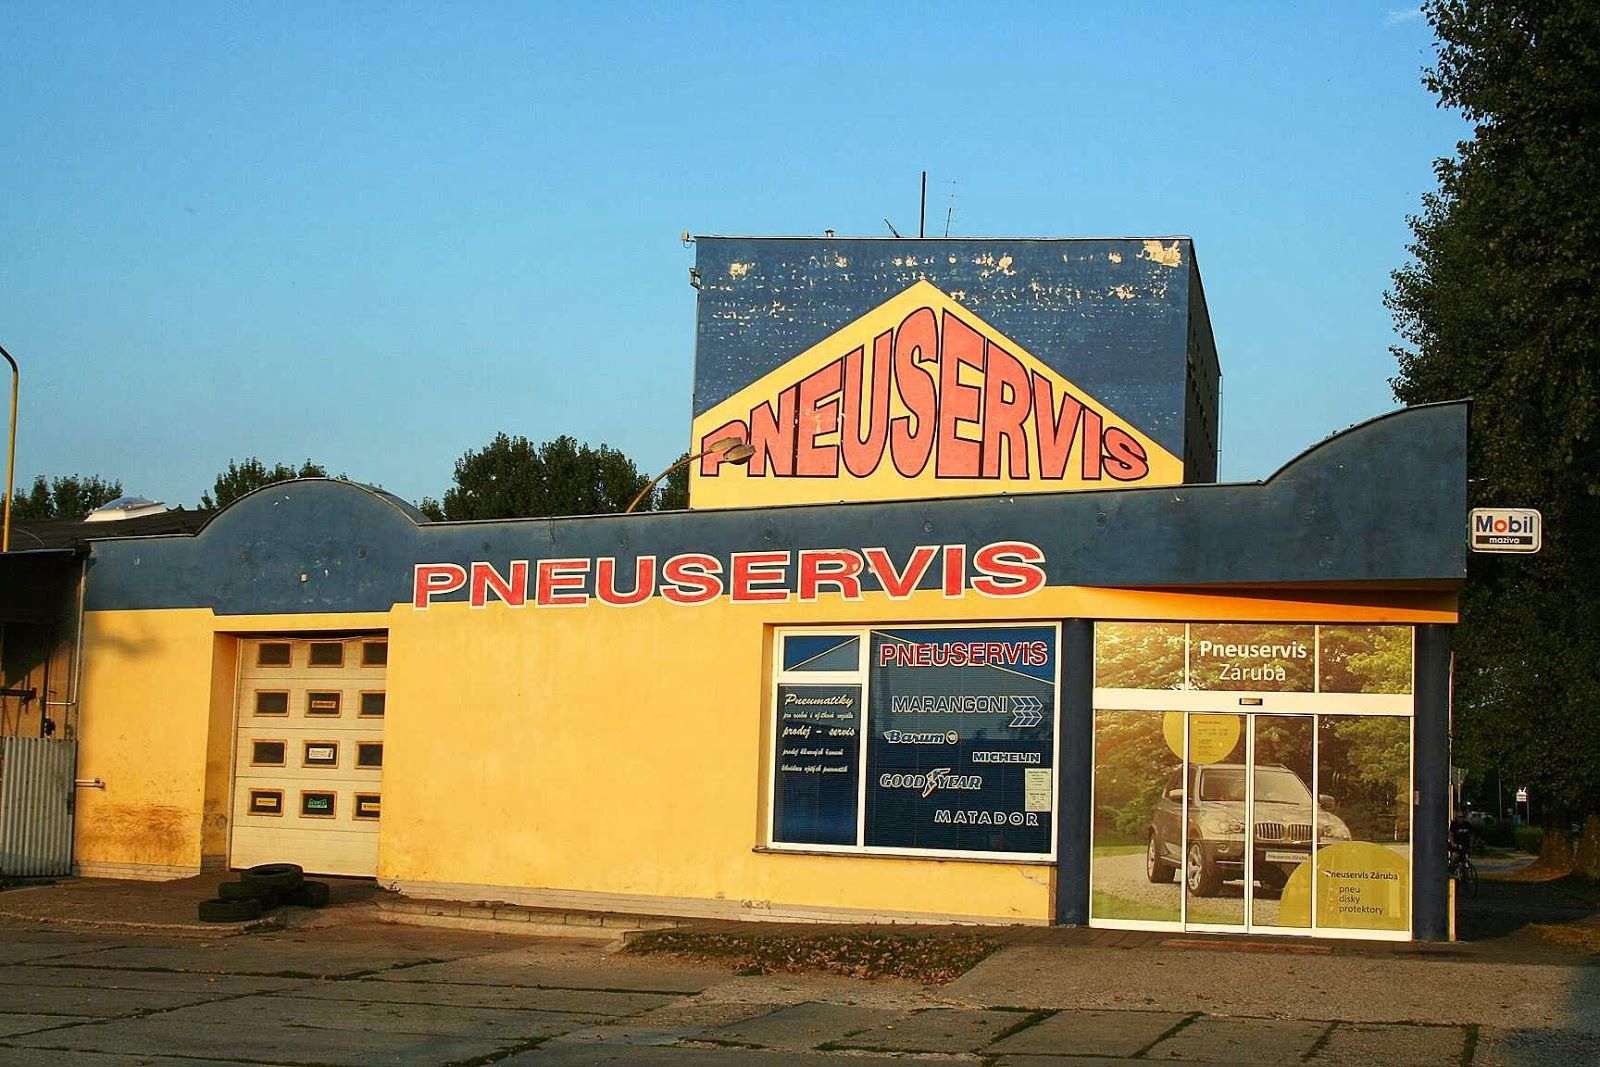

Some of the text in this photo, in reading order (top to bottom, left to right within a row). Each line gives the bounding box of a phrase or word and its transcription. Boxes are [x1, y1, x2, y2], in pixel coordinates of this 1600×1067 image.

[700, 306, 1149, 481] PNEUSERVIS
[1476, 515, 1533, 533] Mobil
[412, 541, 1047, 611] PNEUSERVIS
[879, 641, 1048, 668] PNEUSERVIS
[1200, 640, 1307, 659] Pneuservis
[1219, 663, 1287, 682] Záruba
[784, 693, 854, 708] Pneumatiky
[891, 695, 1008, 713] MARANGONI
[782, 724, 812, 739] prodej
[829, 727, 856, 737] servis
[883, 729, 946, 744] Barum
[972, 752, 1041, 764] MICHELIN
[934, 809, 1039, 826] MATADOR
[1370, 871, 1398, 880] Záruba
[1339, 895, 1360, 904] disky
[1339, 904, 1384, 915] protektory
